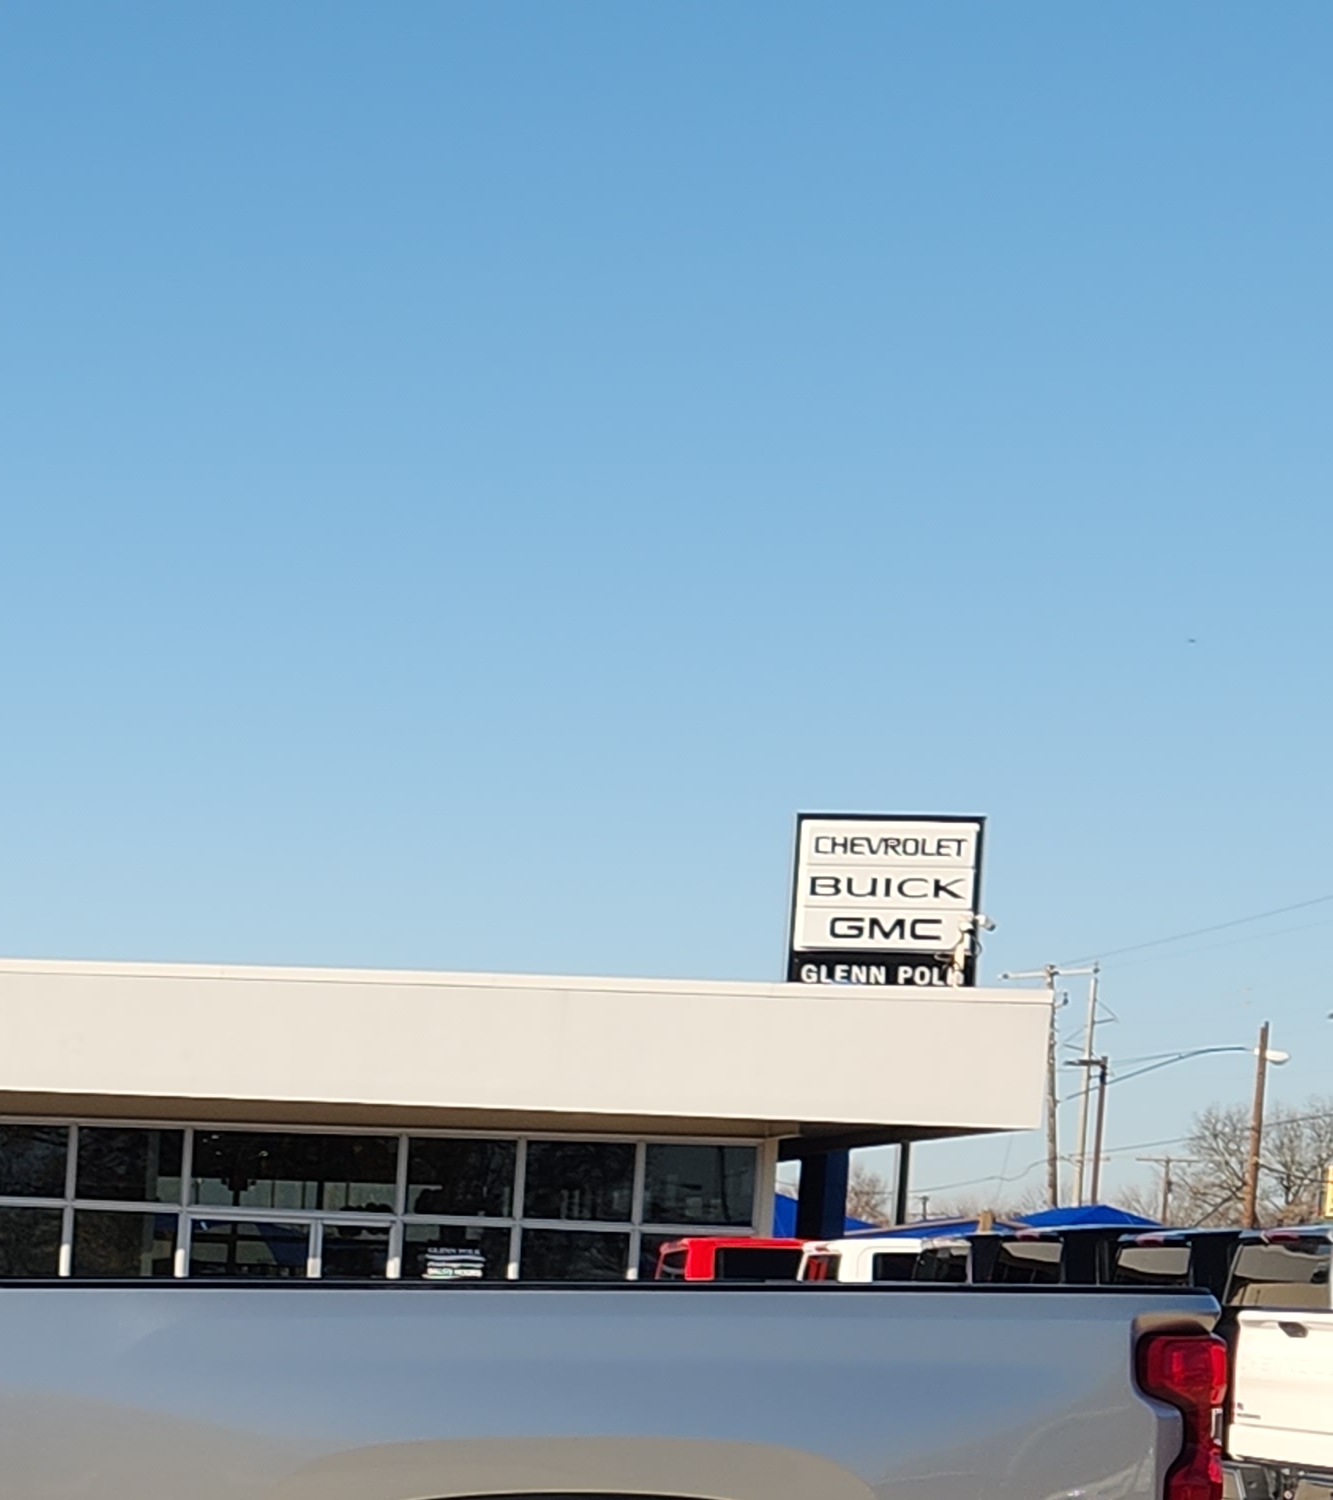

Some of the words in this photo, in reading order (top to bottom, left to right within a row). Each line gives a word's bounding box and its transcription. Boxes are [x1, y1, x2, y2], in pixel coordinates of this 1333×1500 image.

[814, 836, 968, 856] CHEVROLET
[809, 876, 966, 899] BUICK
[830, 917, 942, 940] GMC
[800, 964, 886, 984] GLENN
